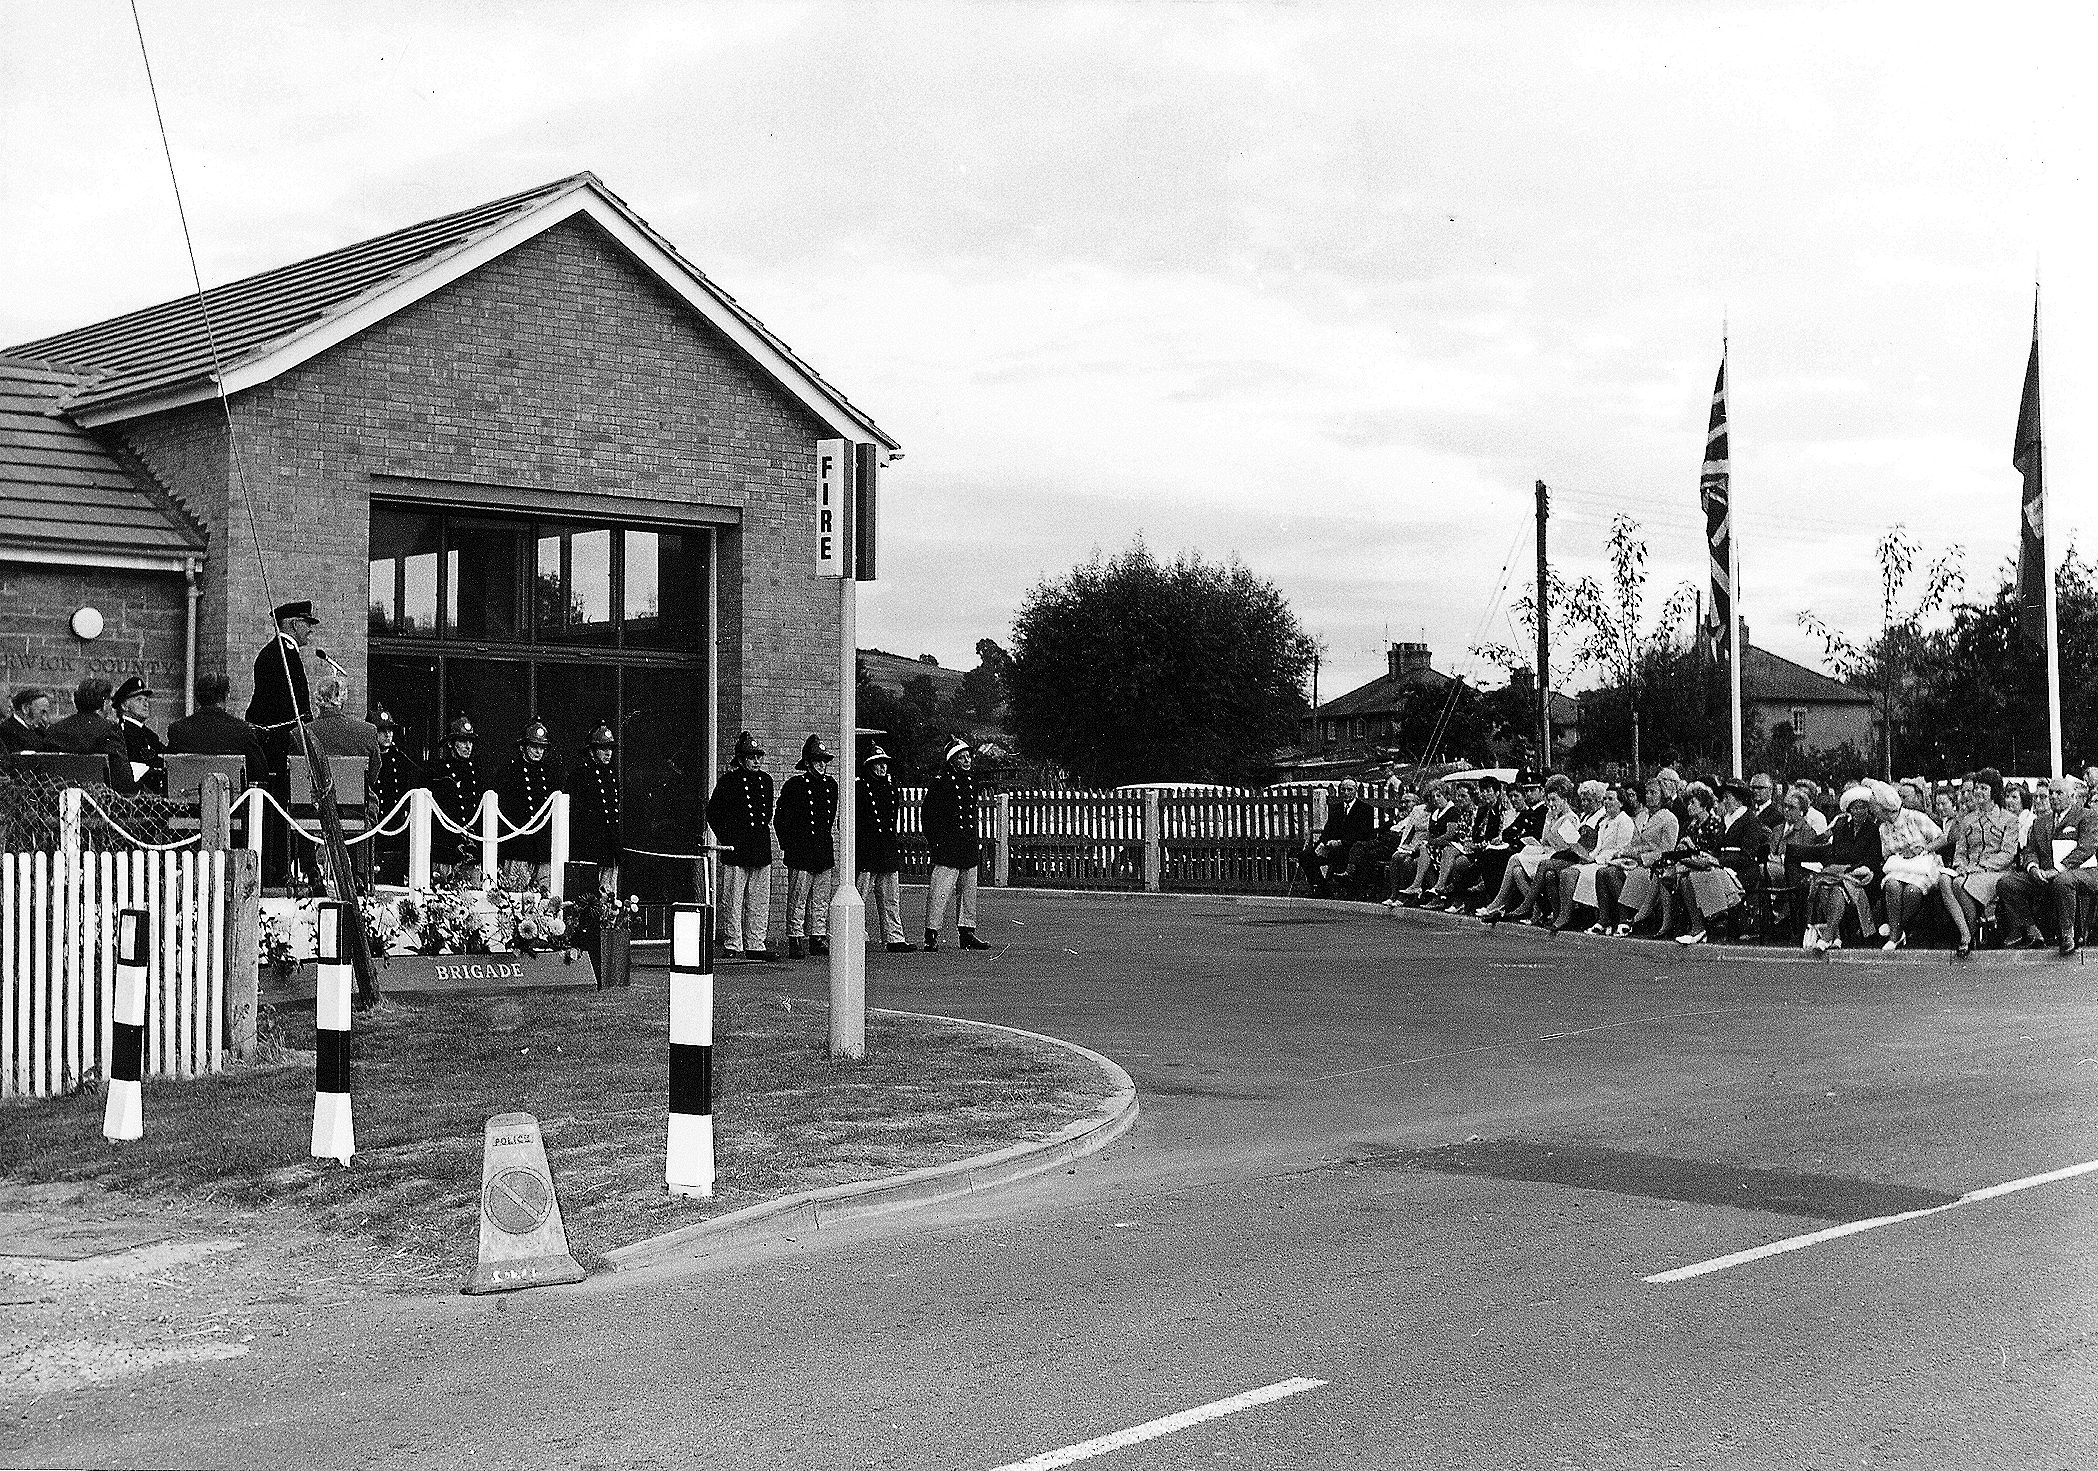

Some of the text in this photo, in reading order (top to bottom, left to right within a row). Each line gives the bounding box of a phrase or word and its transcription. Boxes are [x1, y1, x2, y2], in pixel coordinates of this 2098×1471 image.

[820, 455, 833, 560] FIRE
[0, 654, 176, 676] RWICK COUNTY
[435, 963, 525, 981] BRIGADE
[492, 1134, 534, 1147] POLICE
